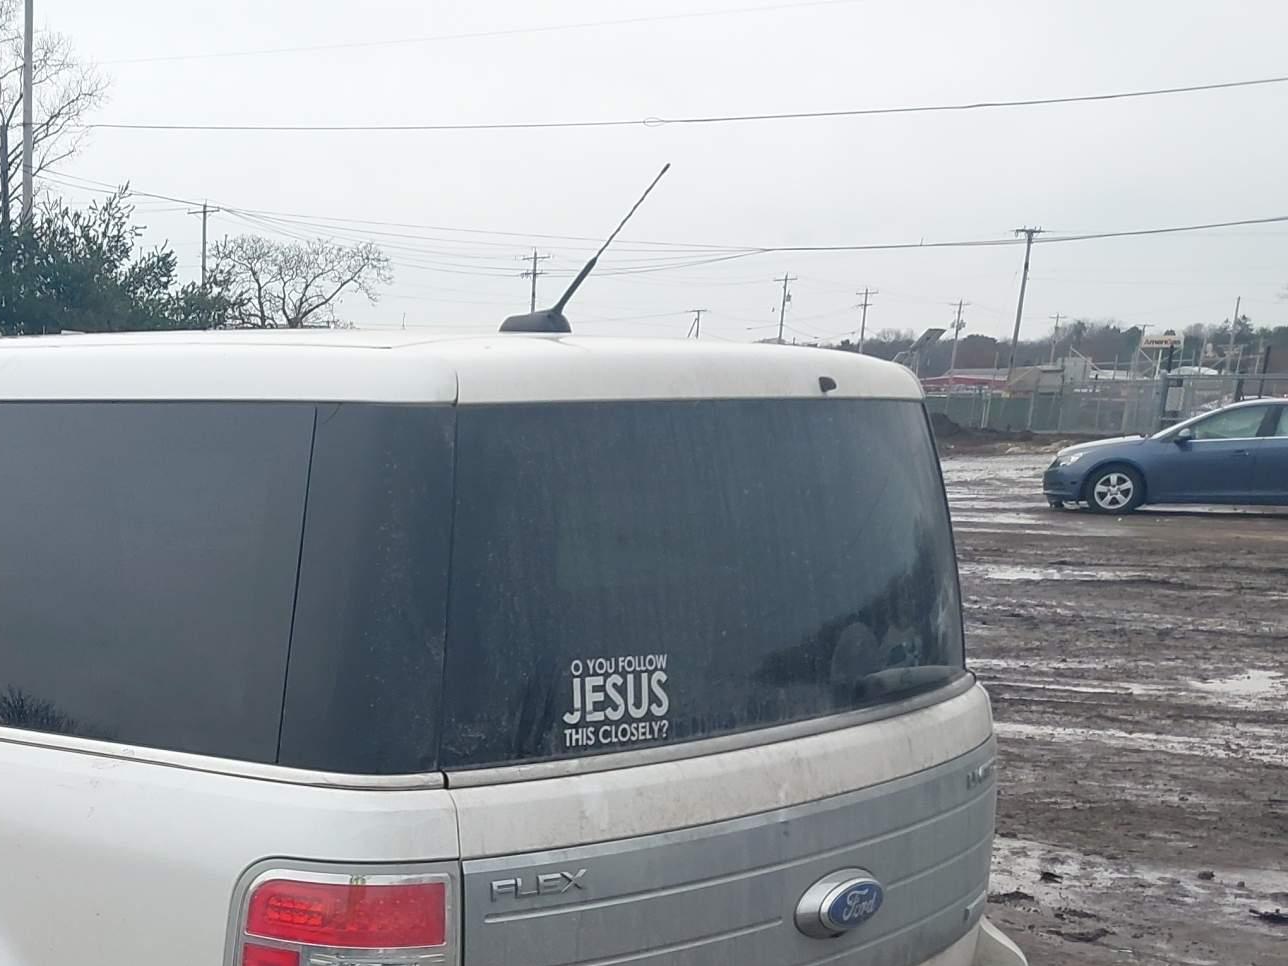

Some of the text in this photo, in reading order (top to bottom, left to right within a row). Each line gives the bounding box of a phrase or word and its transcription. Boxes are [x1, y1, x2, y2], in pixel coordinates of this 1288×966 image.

[571, 654, 668, 676] O YOU FOLLOW
[563, 671, 669, 724] JESUS
[564, 720, 669, 746] THIS CLOSELY?
[490, 868, 588, 902] FLEX
[842, 887, 877, 921] Ford
